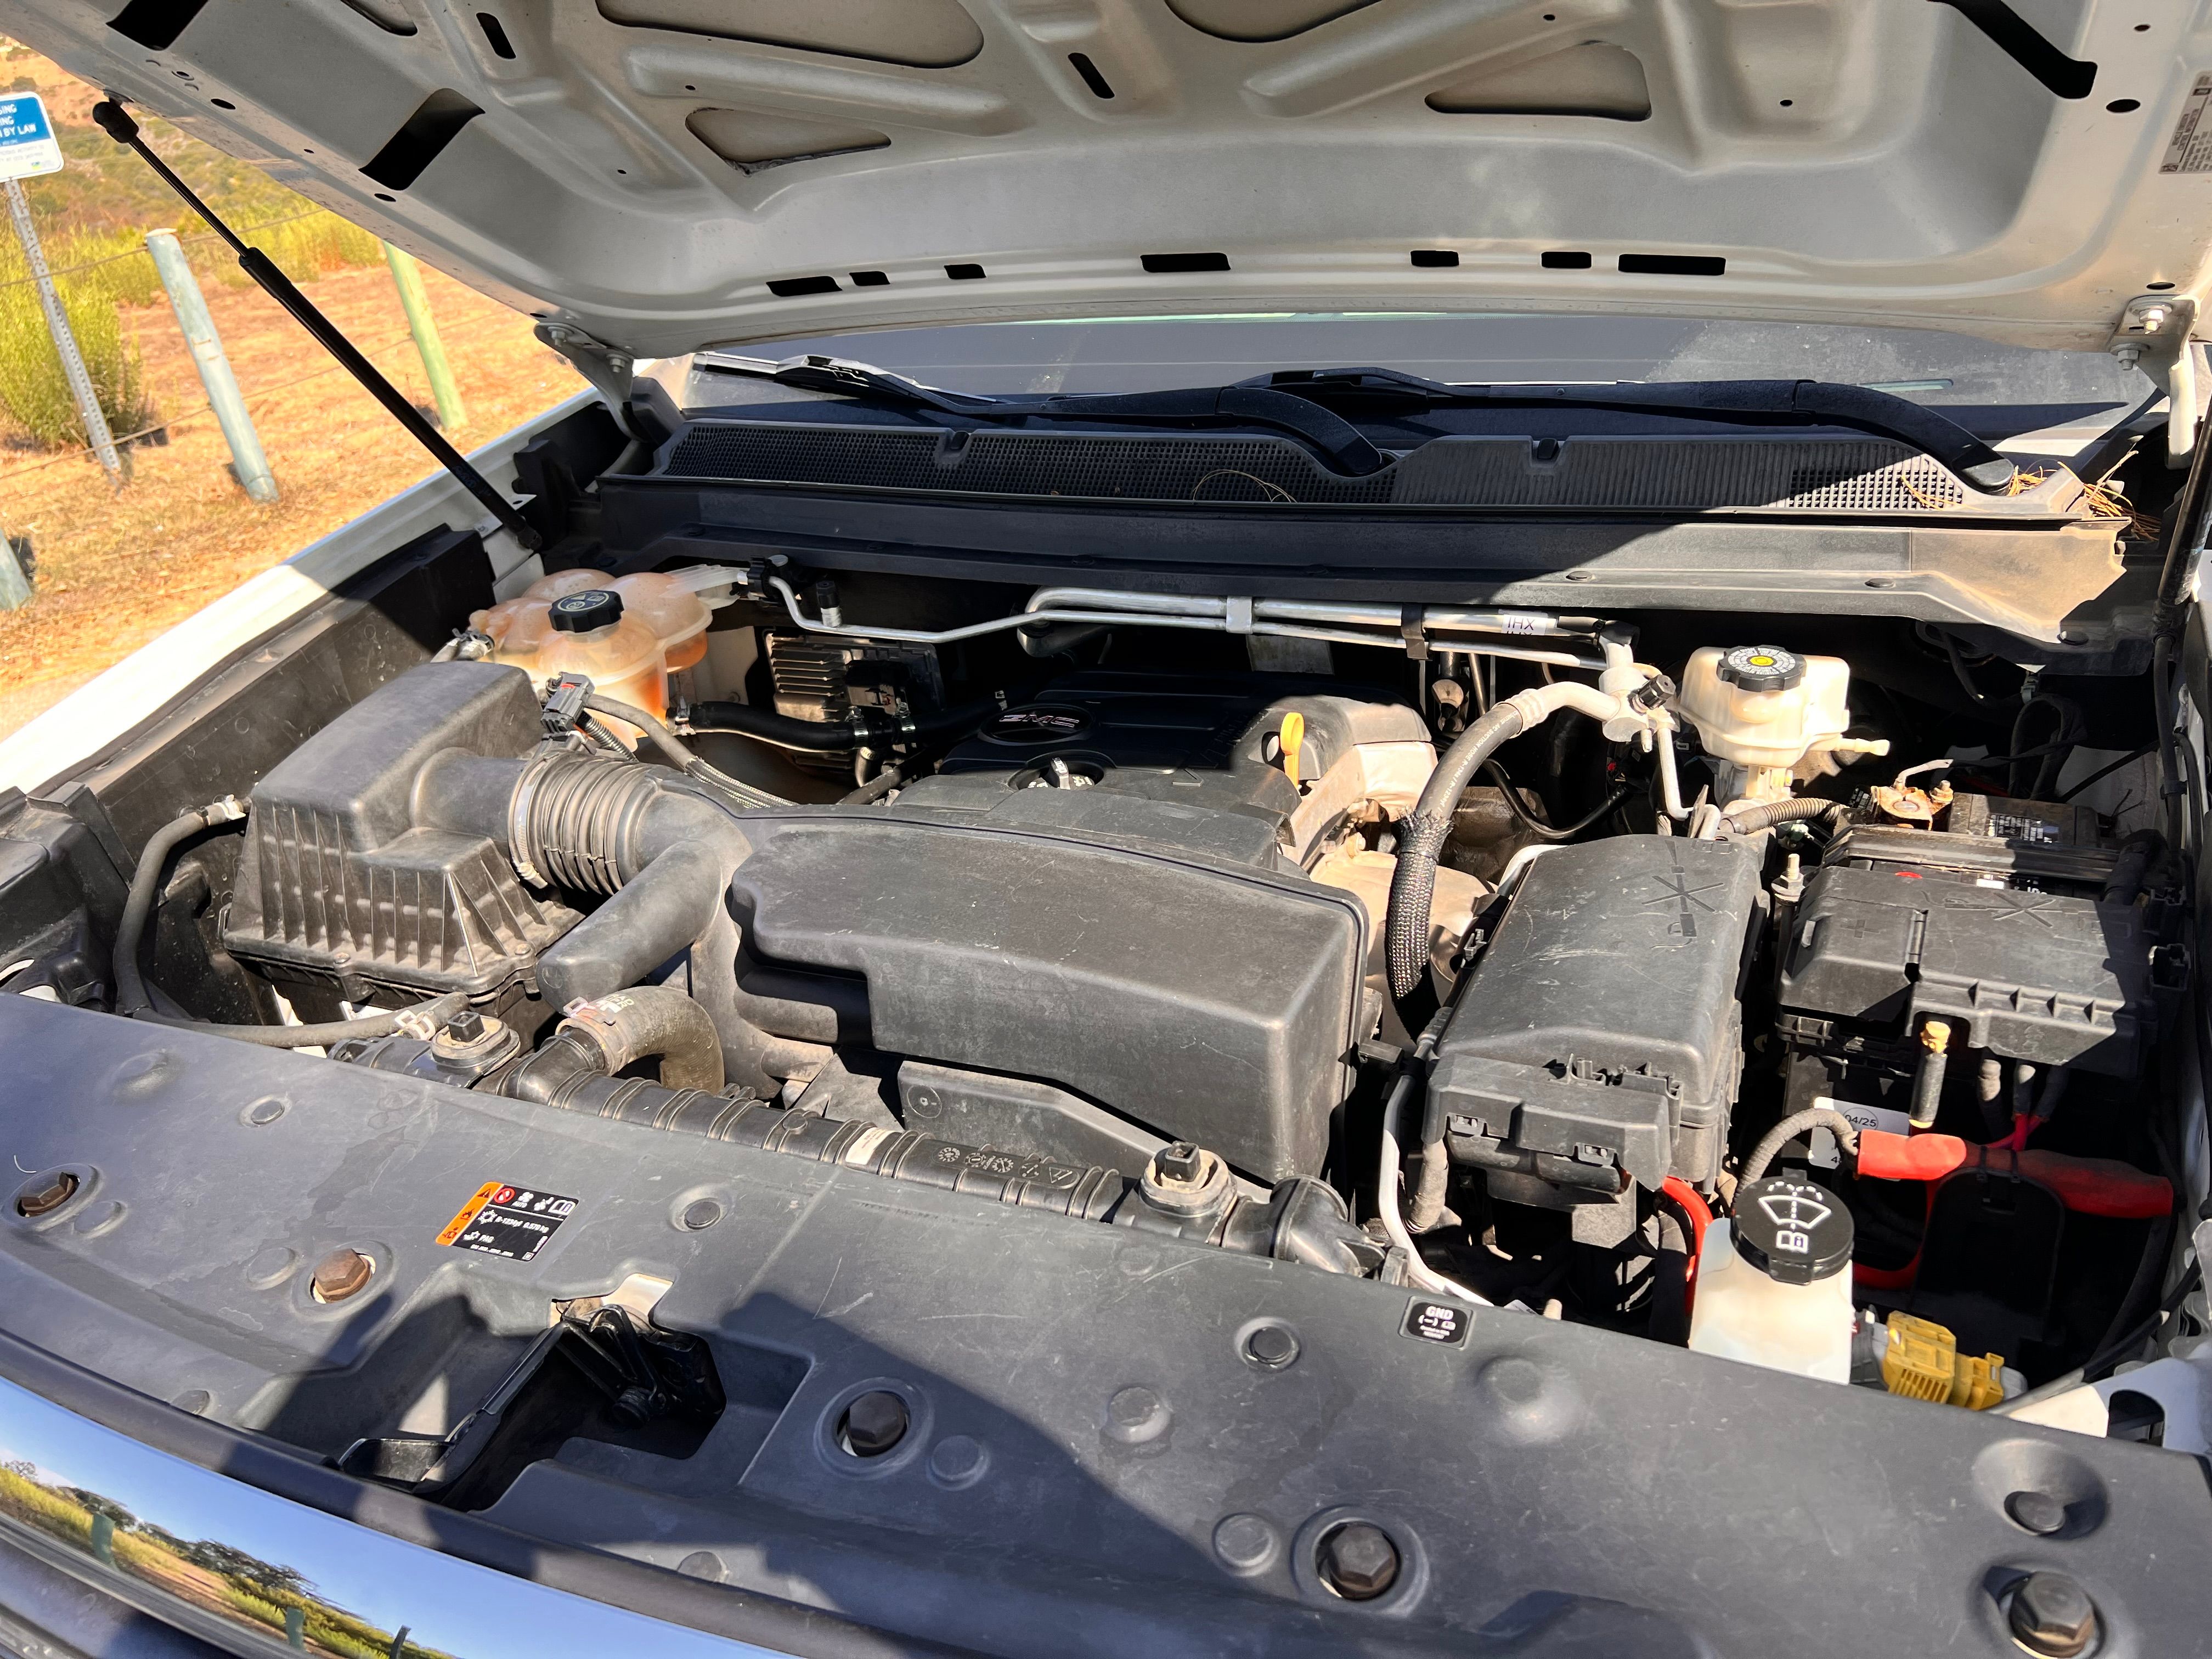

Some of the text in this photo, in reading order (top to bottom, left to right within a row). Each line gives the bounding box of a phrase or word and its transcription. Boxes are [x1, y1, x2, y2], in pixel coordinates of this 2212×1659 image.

[3, 127, 15, 137] BY
[17, 123, 36, 135] LAW
[1508, 617, 1536, 631] IHX
[1476, 729, 1494, 748] SUCTION
[1465, 747, 1479, 761] HOSE
[1845, 1114, 1877, 1127] 04/25
[511, 1200, 528, 1209] AUTO
[1425, 1306, 1454, 1321] GND
